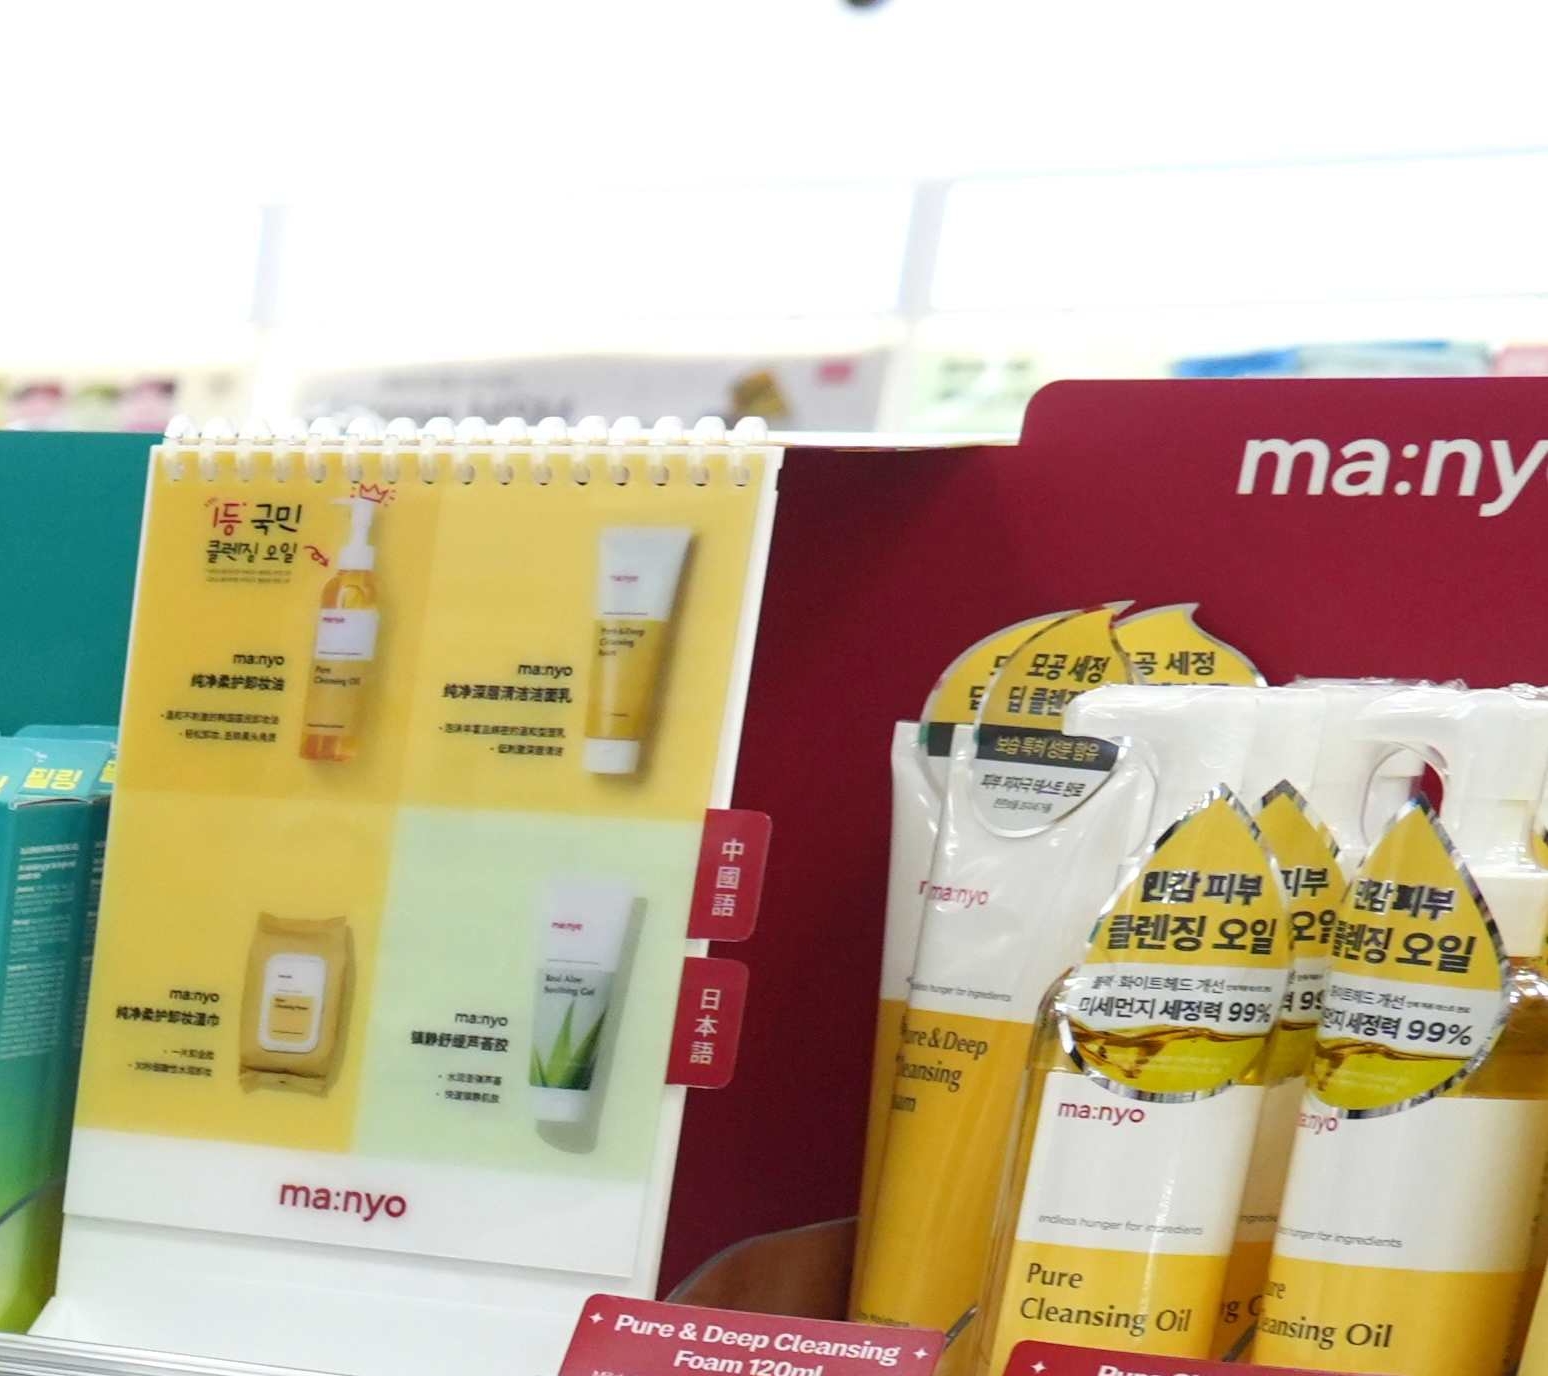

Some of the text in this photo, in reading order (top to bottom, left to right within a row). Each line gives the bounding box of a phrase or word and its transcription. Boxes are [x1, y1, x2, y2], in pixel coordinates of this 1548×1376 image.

[249, 502, 302, 536] 국민
[517, 662, 573, 679] ma:nyo
[1025, 654, 1109, 683] 모공 세정
[1203, 870, 1262, 906] 피부
[1106, 912, 1277, 955] 클렌징 오일
[690, 988, 722, 1066] 日本語
[1407, 1018, 1473, 1047] 99%
[279, 1180, 408, 1222] ma:nyo
[1027, 1261, 1084, 1291] Pure
[1019, 1296, 1192, 1338] Cleansing Oil
[615, 1315, 901, 1365] Pure & Deep Cleansing
[673, 1350, 743, 1375] Foam
